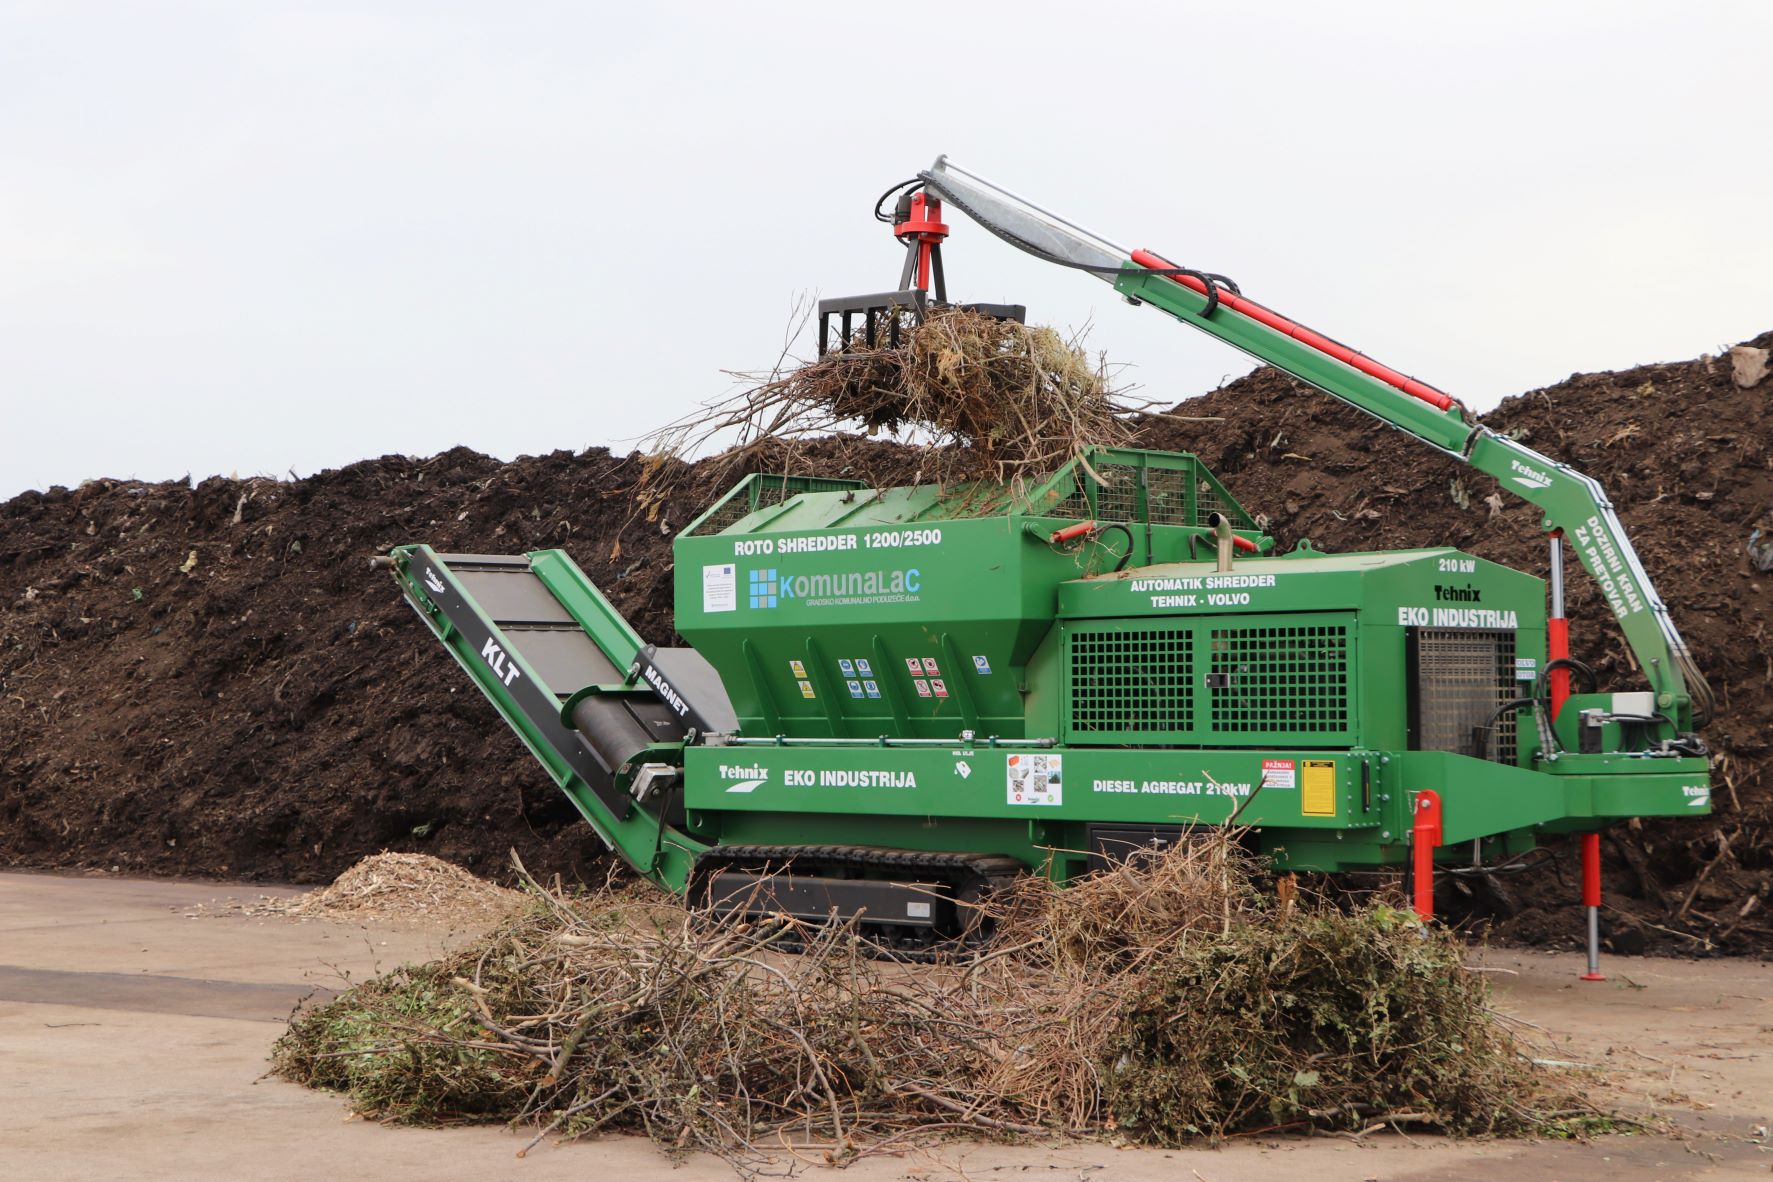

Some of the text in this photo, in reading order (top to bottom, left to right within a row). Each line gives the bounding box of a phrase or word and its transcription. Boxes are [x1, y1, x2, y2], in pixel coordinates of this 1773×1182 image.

[1511, 459, 1553, 487] Tehnix
[734, 528, 942, 557] ROTO SHREDDER 1200/2500
[1439, 558, 1476, 573] 210 kW
[1574, 525, 1628, 619] ZA PRETOVAR
[1587, 515, 1644, 613] DOZIRNI KRAN
[425, 566, 445, 592] Tehnix
[1130, 574, 1276, 592] AUTOMATIK SHREDDER
[834, 595, 873, 606] KOMUNALNO
[1150, 594, 1197, 608] TEHNIX
[1207, 592, 1250, 606] VOLVO
[1434, 583, 1481, 602] Tehnix
[1398, 606, 1519, 629] EKO INDUSTRIJA
[481, 636, 521, 687] KLT
[644, 664, 690, 718] MAGNET
[719, 762, 769, 780] Tehnix
[784, 769, 917, 789] EKO INDUSTRIJA
[1093, 780, 1251, 797] DIESEL AGREGAT 210kW
